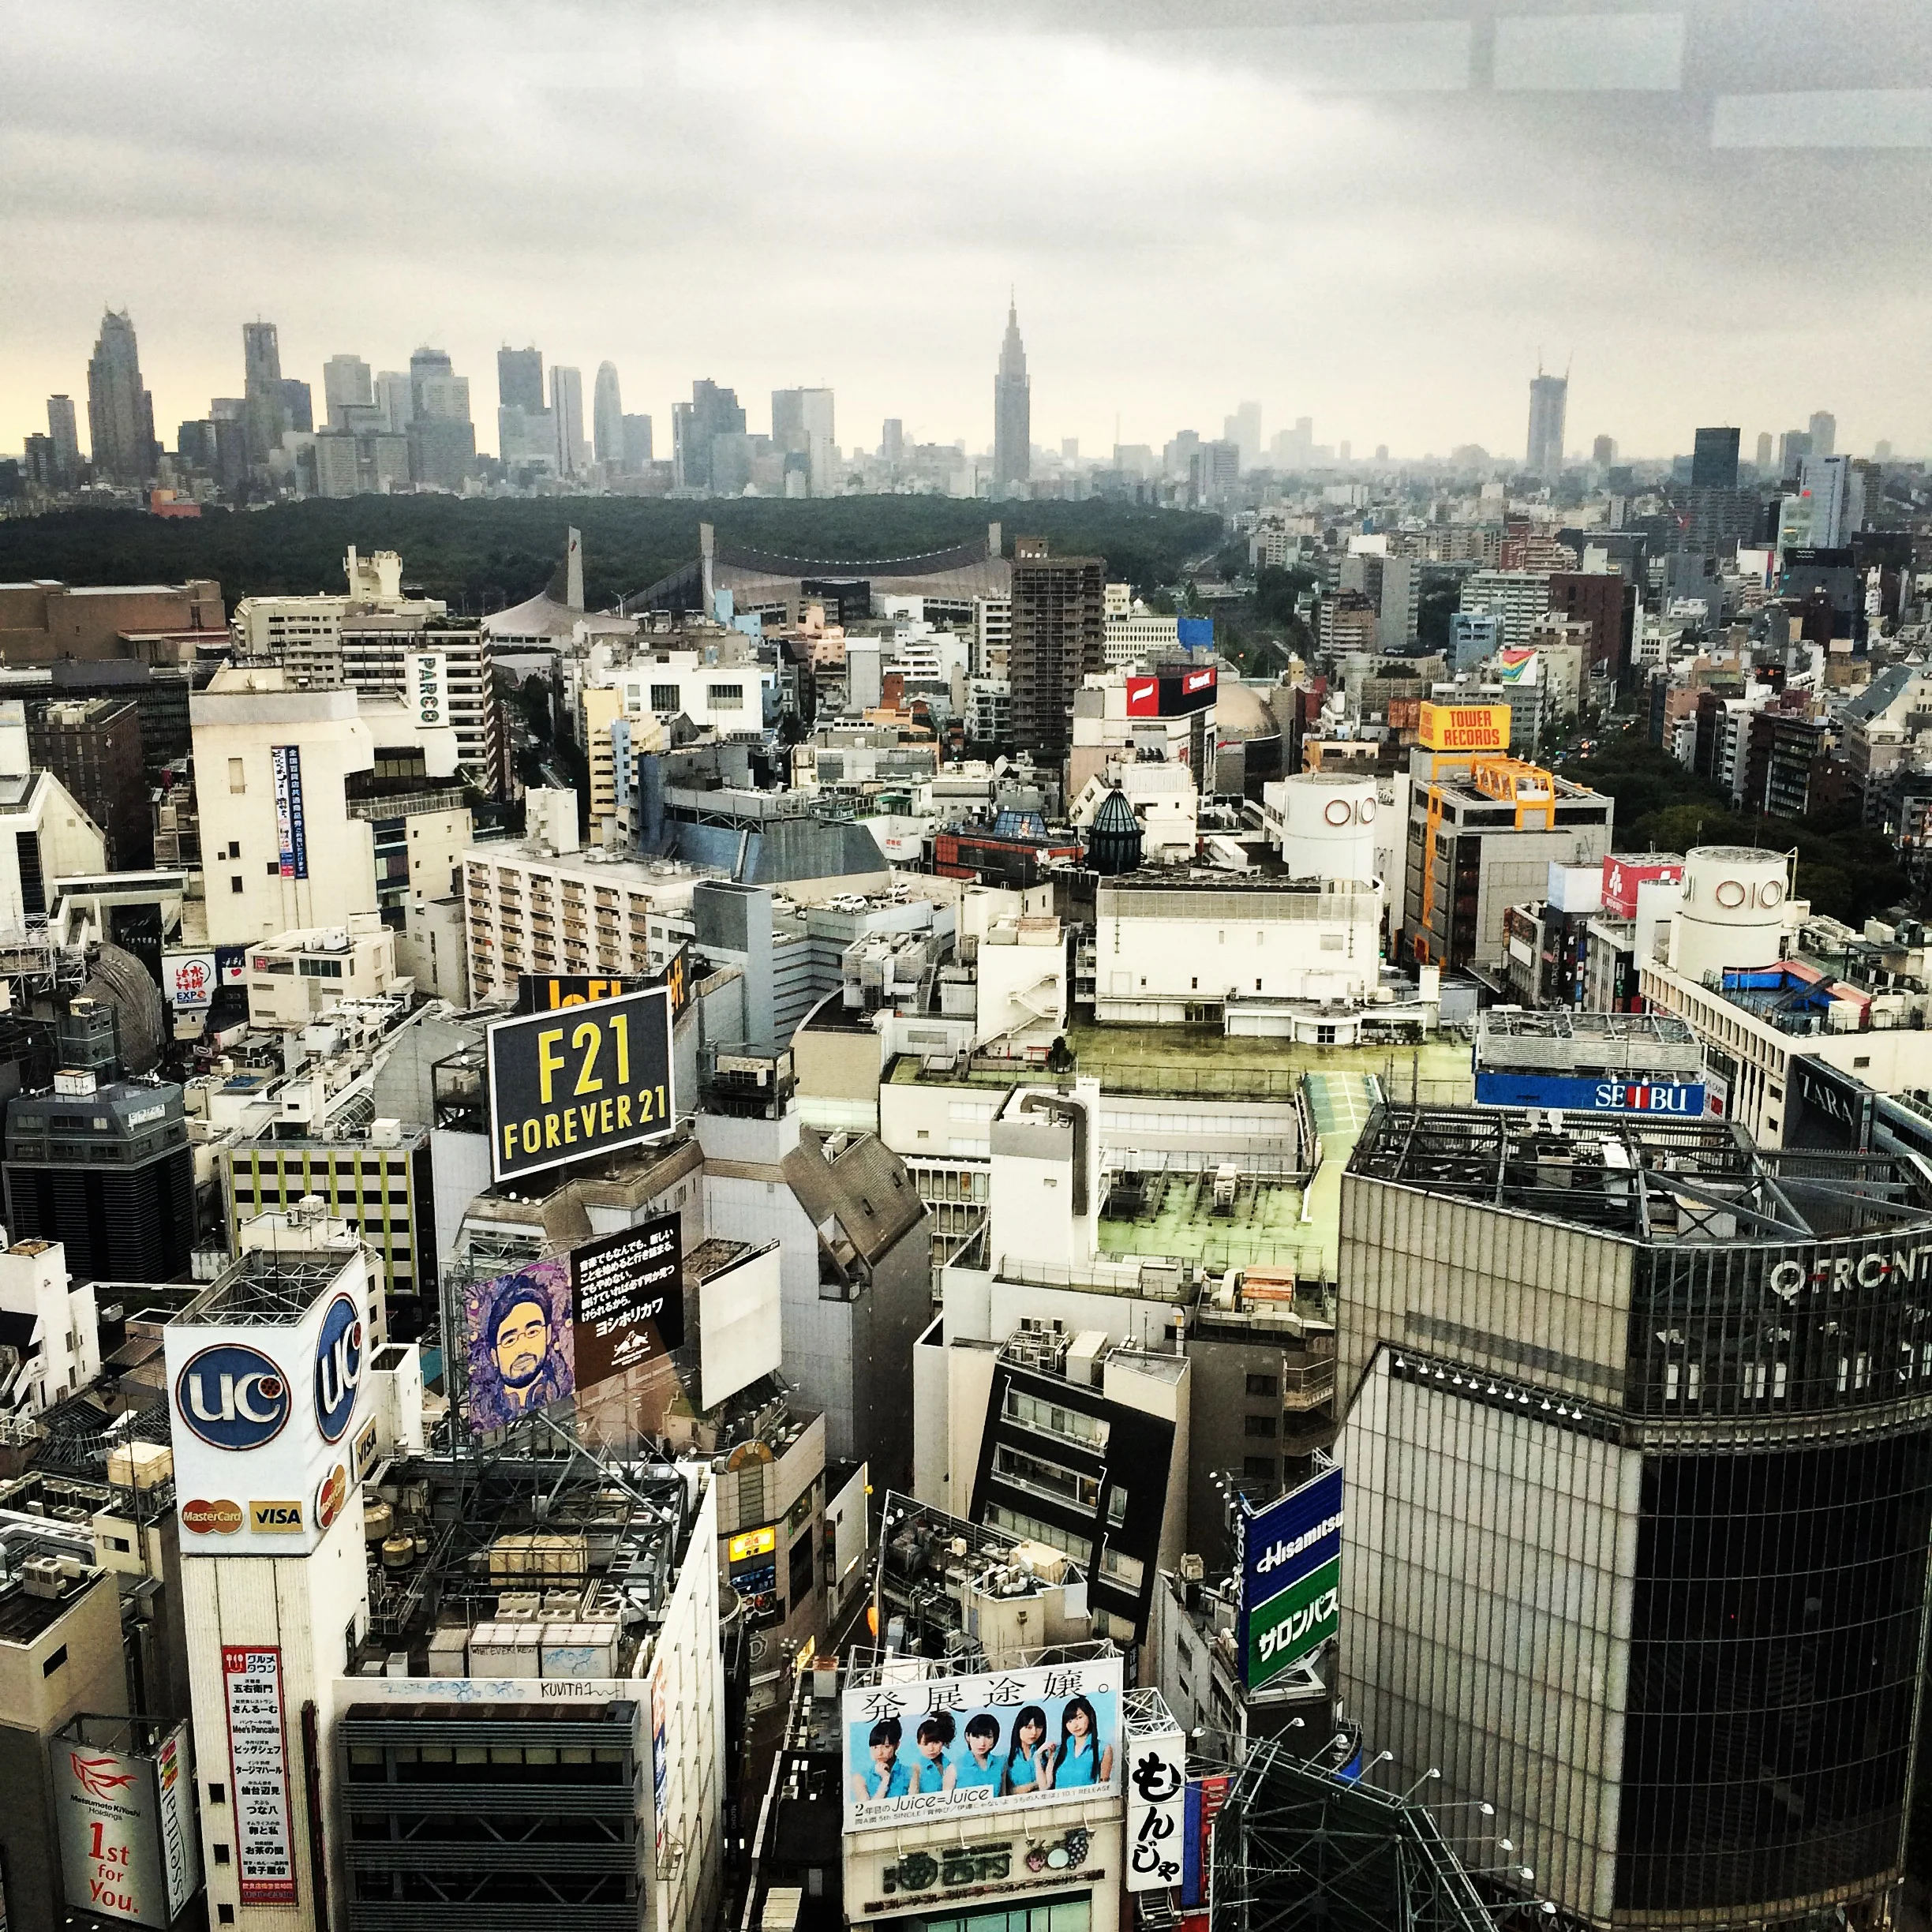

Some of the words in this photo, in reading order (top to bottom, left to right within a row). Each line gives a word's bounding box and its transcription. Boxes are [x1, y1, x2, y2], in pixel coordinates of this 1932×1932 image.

[418, 658, 440, 723] PARCO
[1449, 710, 1492, 727] TOWER
[1443, 728, 1500, 746] RECORDS
[538, 1013, 630, 1105] F21
[1595, 1084, 1687, 1111] SEIBU
[1799, 1072, 1853, 1126] ZARA
[504, 1095, 632, 1160] FOREVER
[638, 1085, 665, 1124] 21
[596, 1297, 664, 1338] ヨシホリカワ
[358, 1428, 377, 1466] VISA
[183, 1510, 243, 1523] MasterCard
[256, 1508, 301, 1525] VISA
[1256, 1511, 1344, 1573] Hisamitsu
[1259, 1586, 1339, 1662] サロンパス
[248, 1654, 275, 1664] グルメ
[248, 1664, 275, 1673] タウン
[233, 1684, 273, 1694] 五右衛門
[861, 1670, 1110, 1724] 発展途嬢。
[252, 1725, 279, 1734] Pancake
[234, 1745, 281, 1754] ビッグシェフ
[235, 1765, 283, 1775] タージマハール
[241, 1785, 281, 1795] 仙台辺見
[892, 1788, 990, 1812] Juice=Juice
[69, 1794, 113, 1811] Matsumoto
[246, 1806, 279, 1815] つな八
[88, 1807, 122, 1822] Holdings
[1132, 1751, 1181, 1882] もんじゃ
[88, 1822, 130, 1866] 1st
[162, 1785, 185, 1917] Essential
[97, 1864, 125, 1882] for
[89, 1878, 139, 1915] You.
